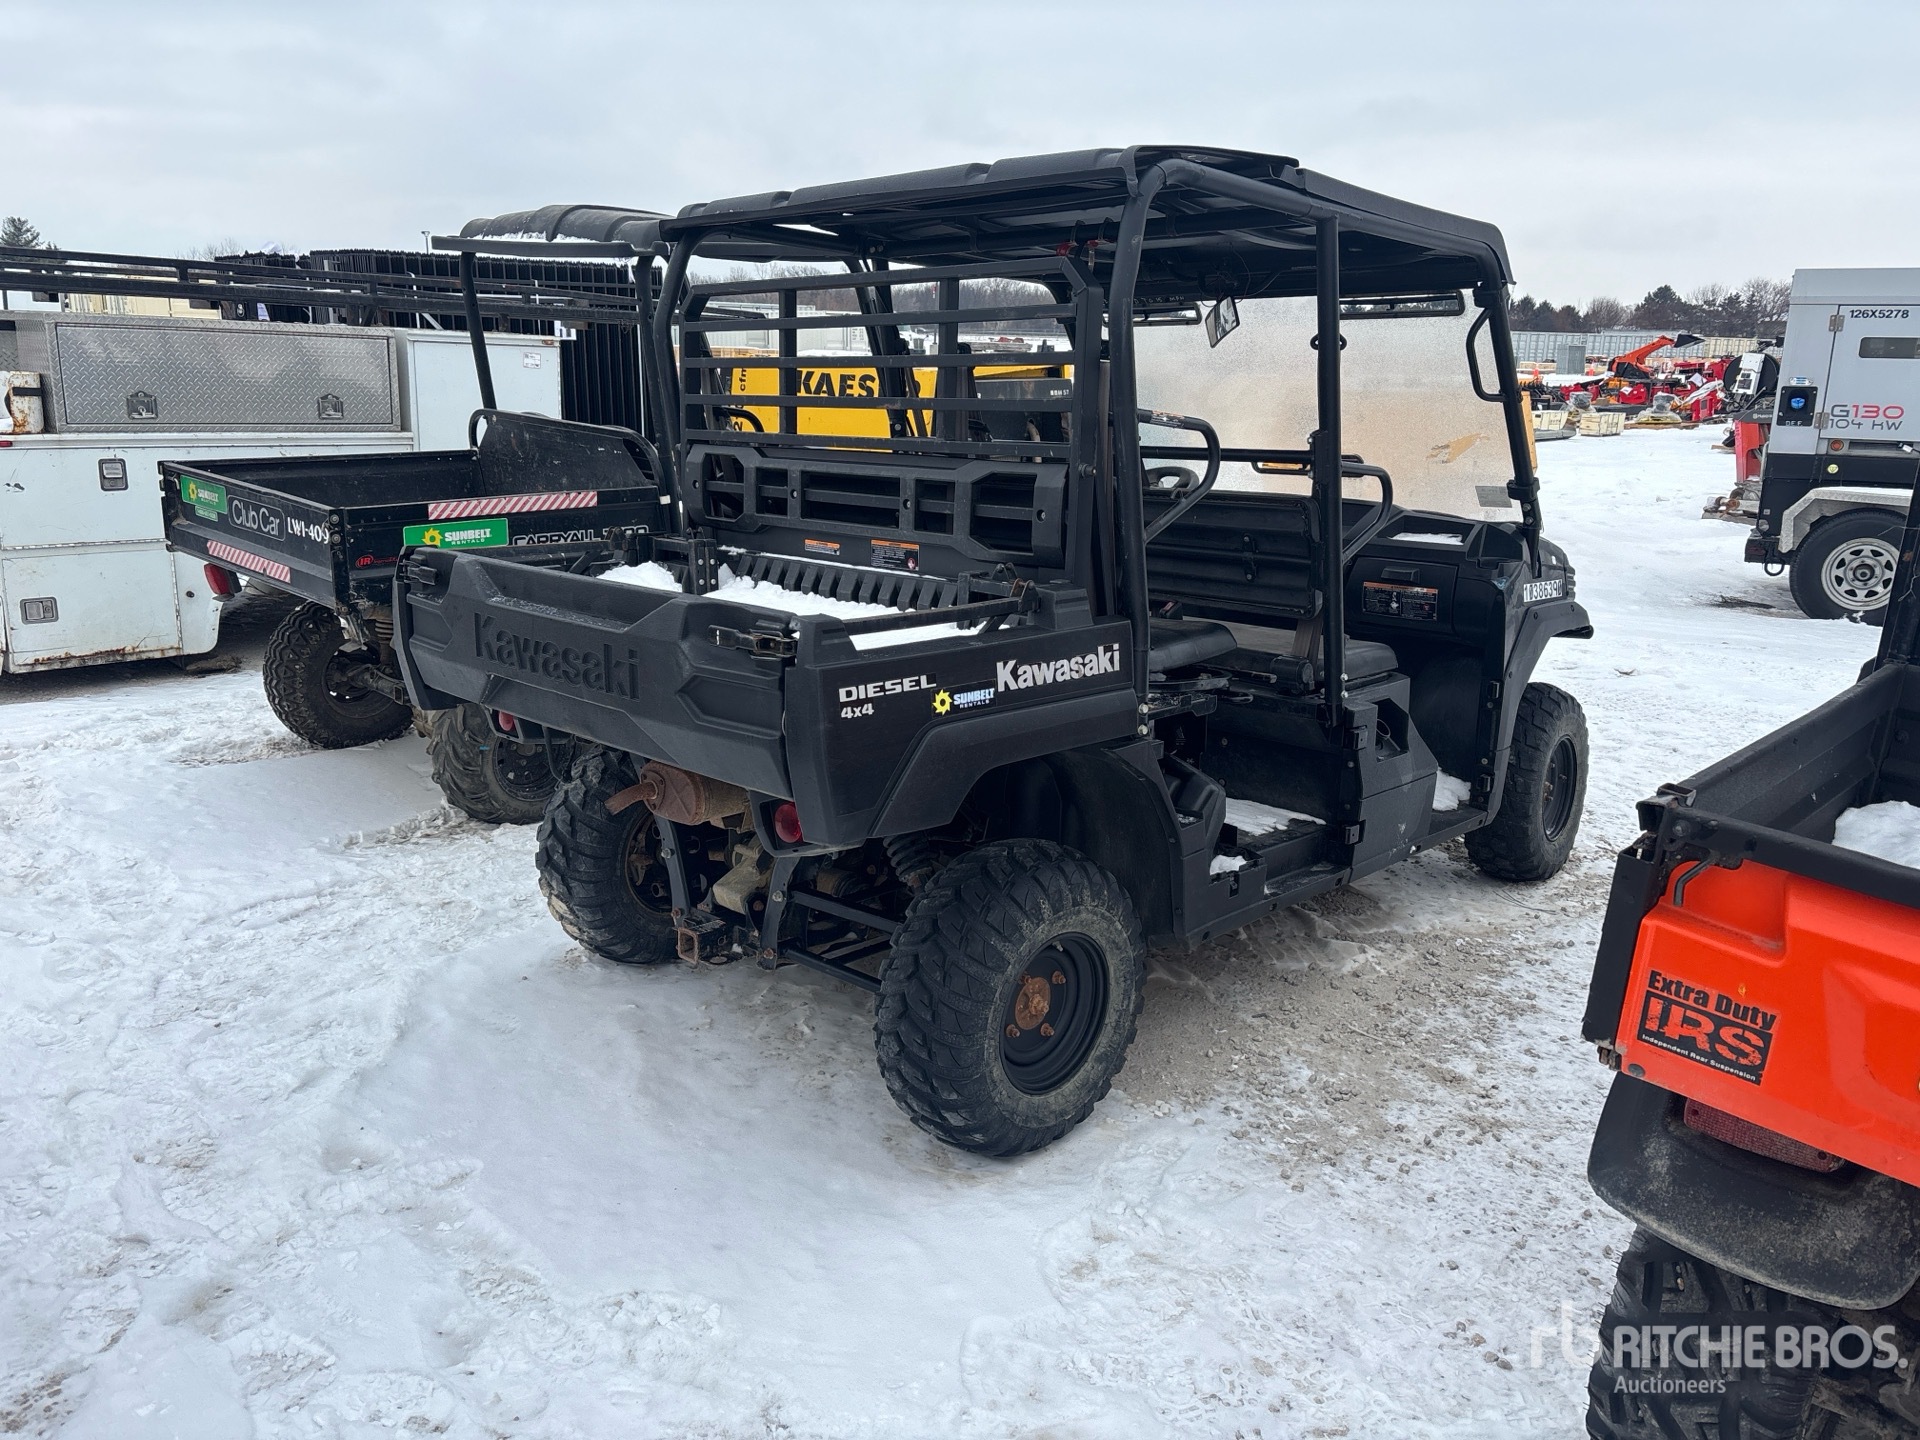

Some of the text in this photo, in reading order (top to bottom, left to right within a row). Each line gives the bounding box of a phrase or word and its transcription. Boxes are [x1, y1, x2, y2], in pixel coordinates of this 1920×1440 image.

[1849, 309, 1910, 319] 126X5278
[797, 370, 920, 397] KAES
[1829, 419, 1864, 430] 104
[1831, 404, 1905, 419] G130
[232, 499, 259, 530] Club
[259, 507, 280, 536] Car
[445, 528, 492, 542] SUNBELT
[451, 538, 485, 546] RENTALS
[474, 612, 640, 700] Kawasaki
[996, 644, 1120, 692] Kawasaki
[839, 675, 937, 702] DIESEL
[953, 688, 995, 706] SUNBELT
[959, 699, 990, 709] RENTALS
[1648, 970, 1777, 1031] Extra Duty
[1645, 997, 1764, 1066] IRS
[1642, 1034, 1756, 1081] Independent Rear Suspension
